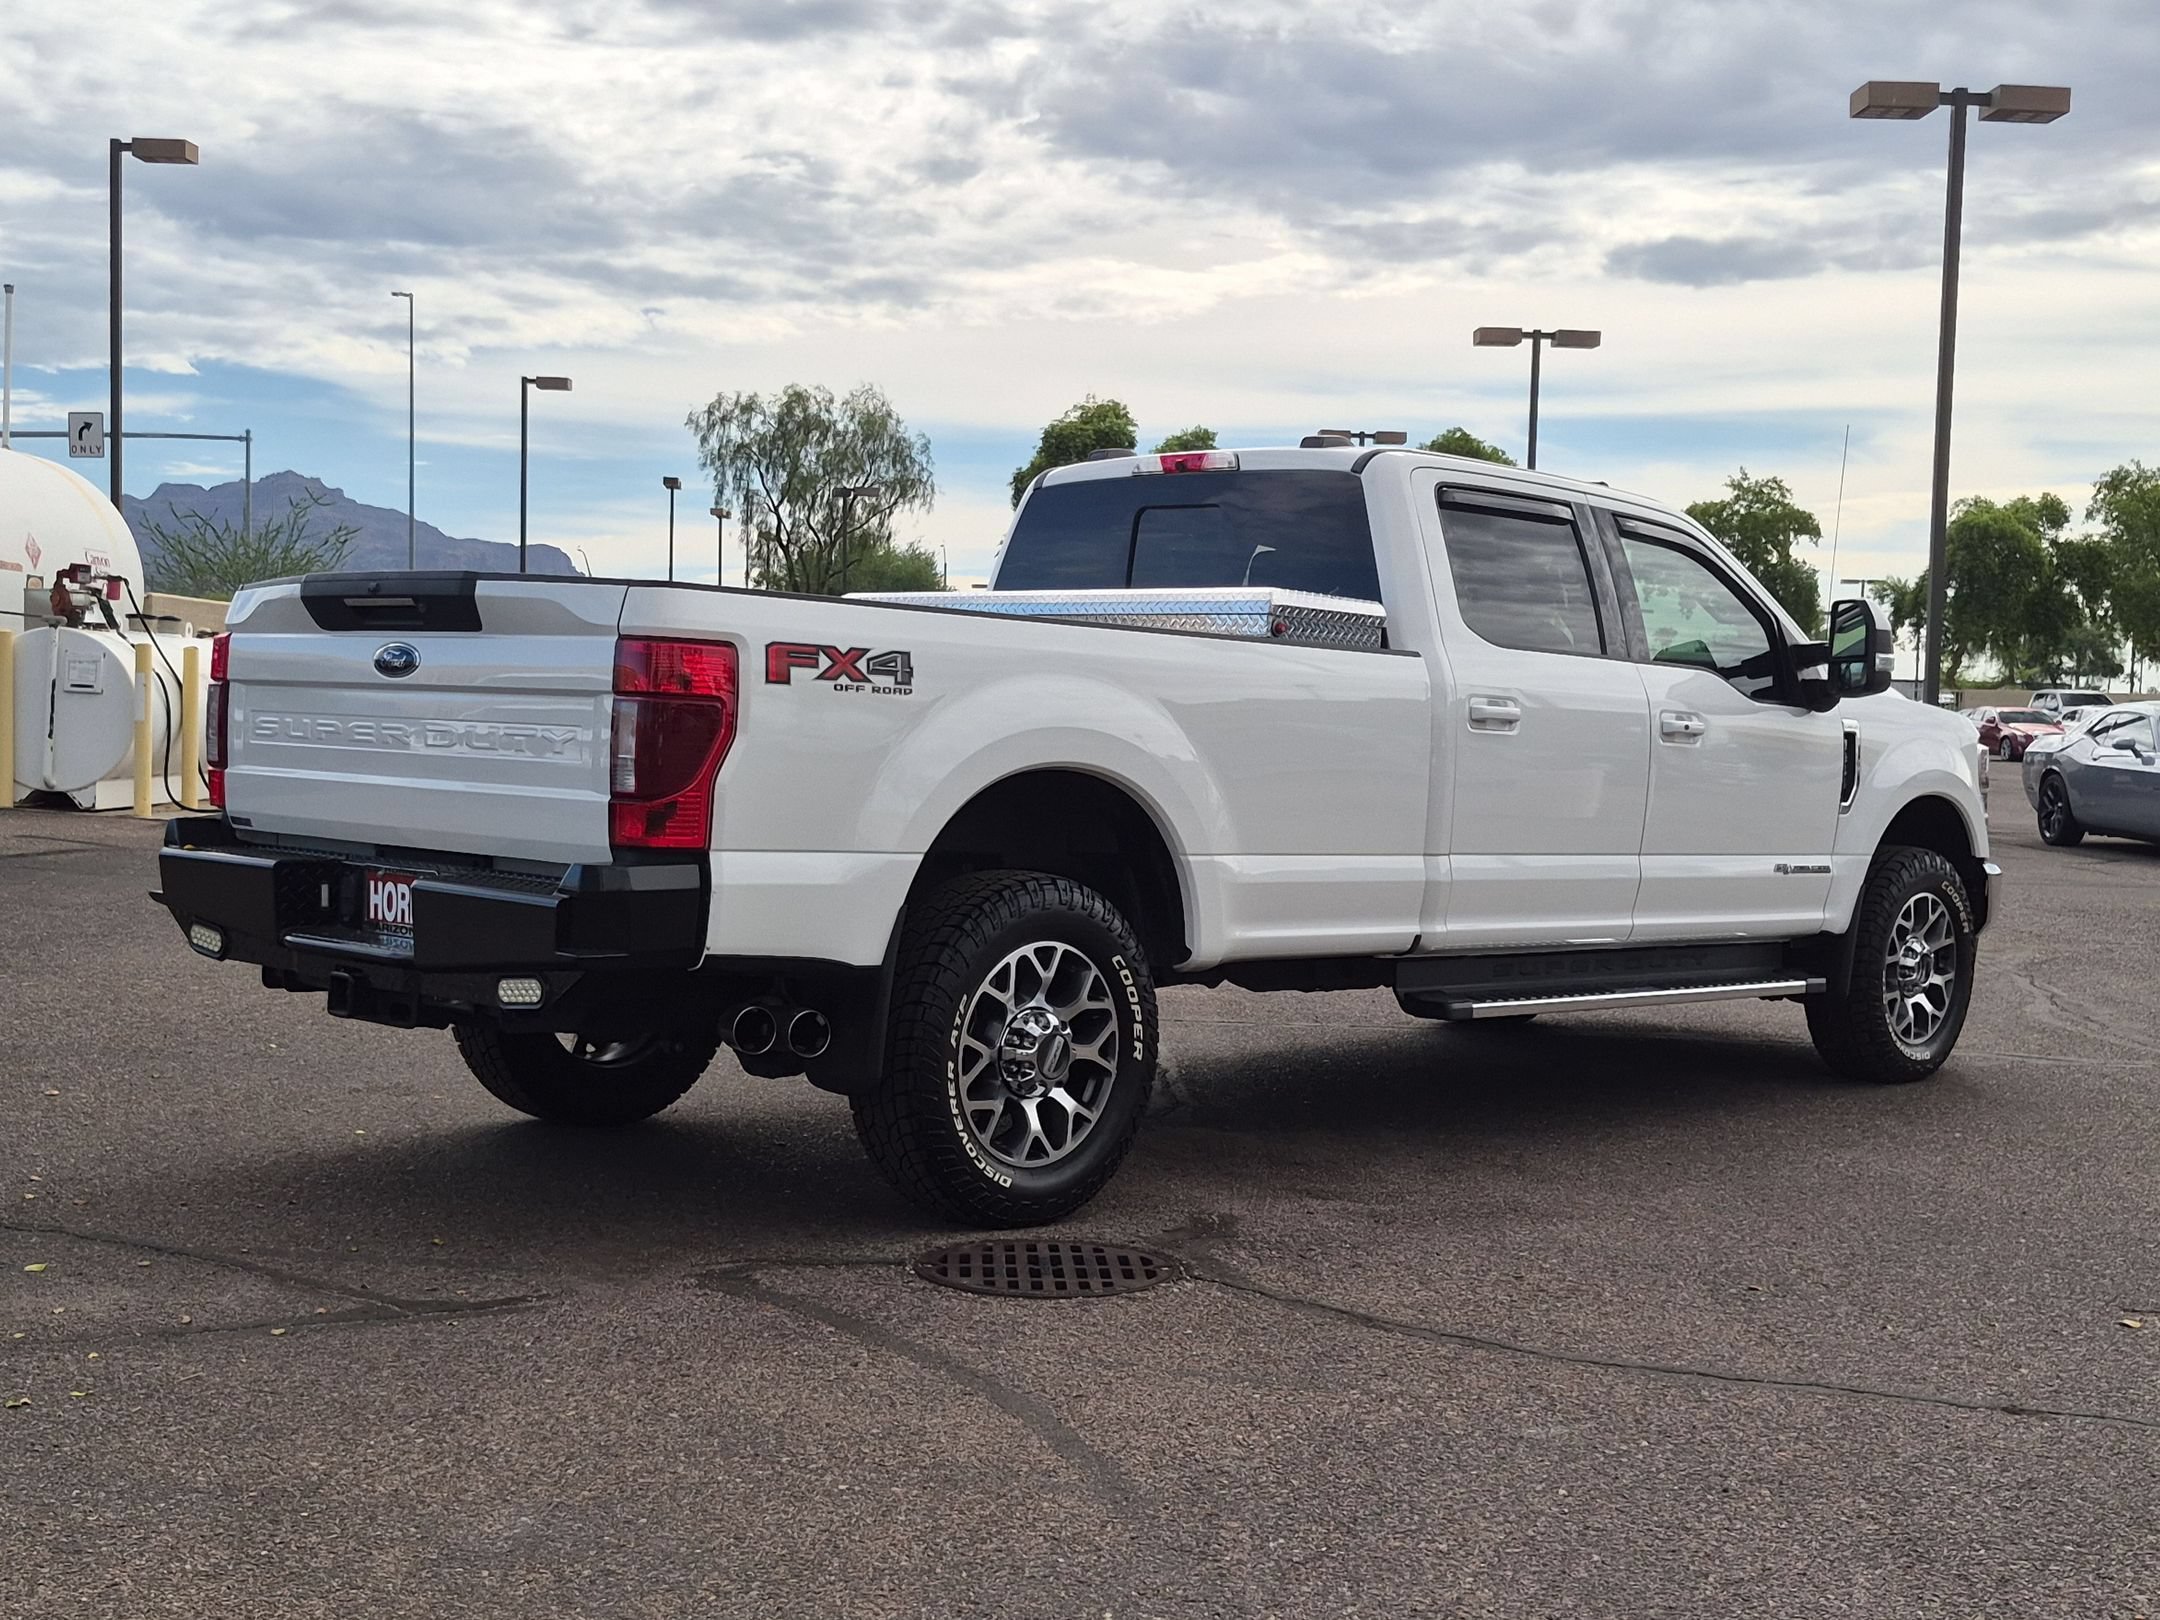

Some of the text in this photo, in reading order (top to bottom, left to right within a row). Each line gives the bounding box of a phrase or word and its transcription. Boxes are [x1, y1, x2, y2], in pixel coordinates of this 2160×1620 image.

[72, 445, 101, 454] ONLY
[765, 641, 913, 686] FX4
[834, 683, 913, 696] OFF ROAD
[255, 716, 578, 755] SUPER DUTY
[1941, 881, 1969, 933] COOPER
[1112, 954, 1143, 1062] COOPER
[947, 1060, 1012, 1189] DISCOVERER
